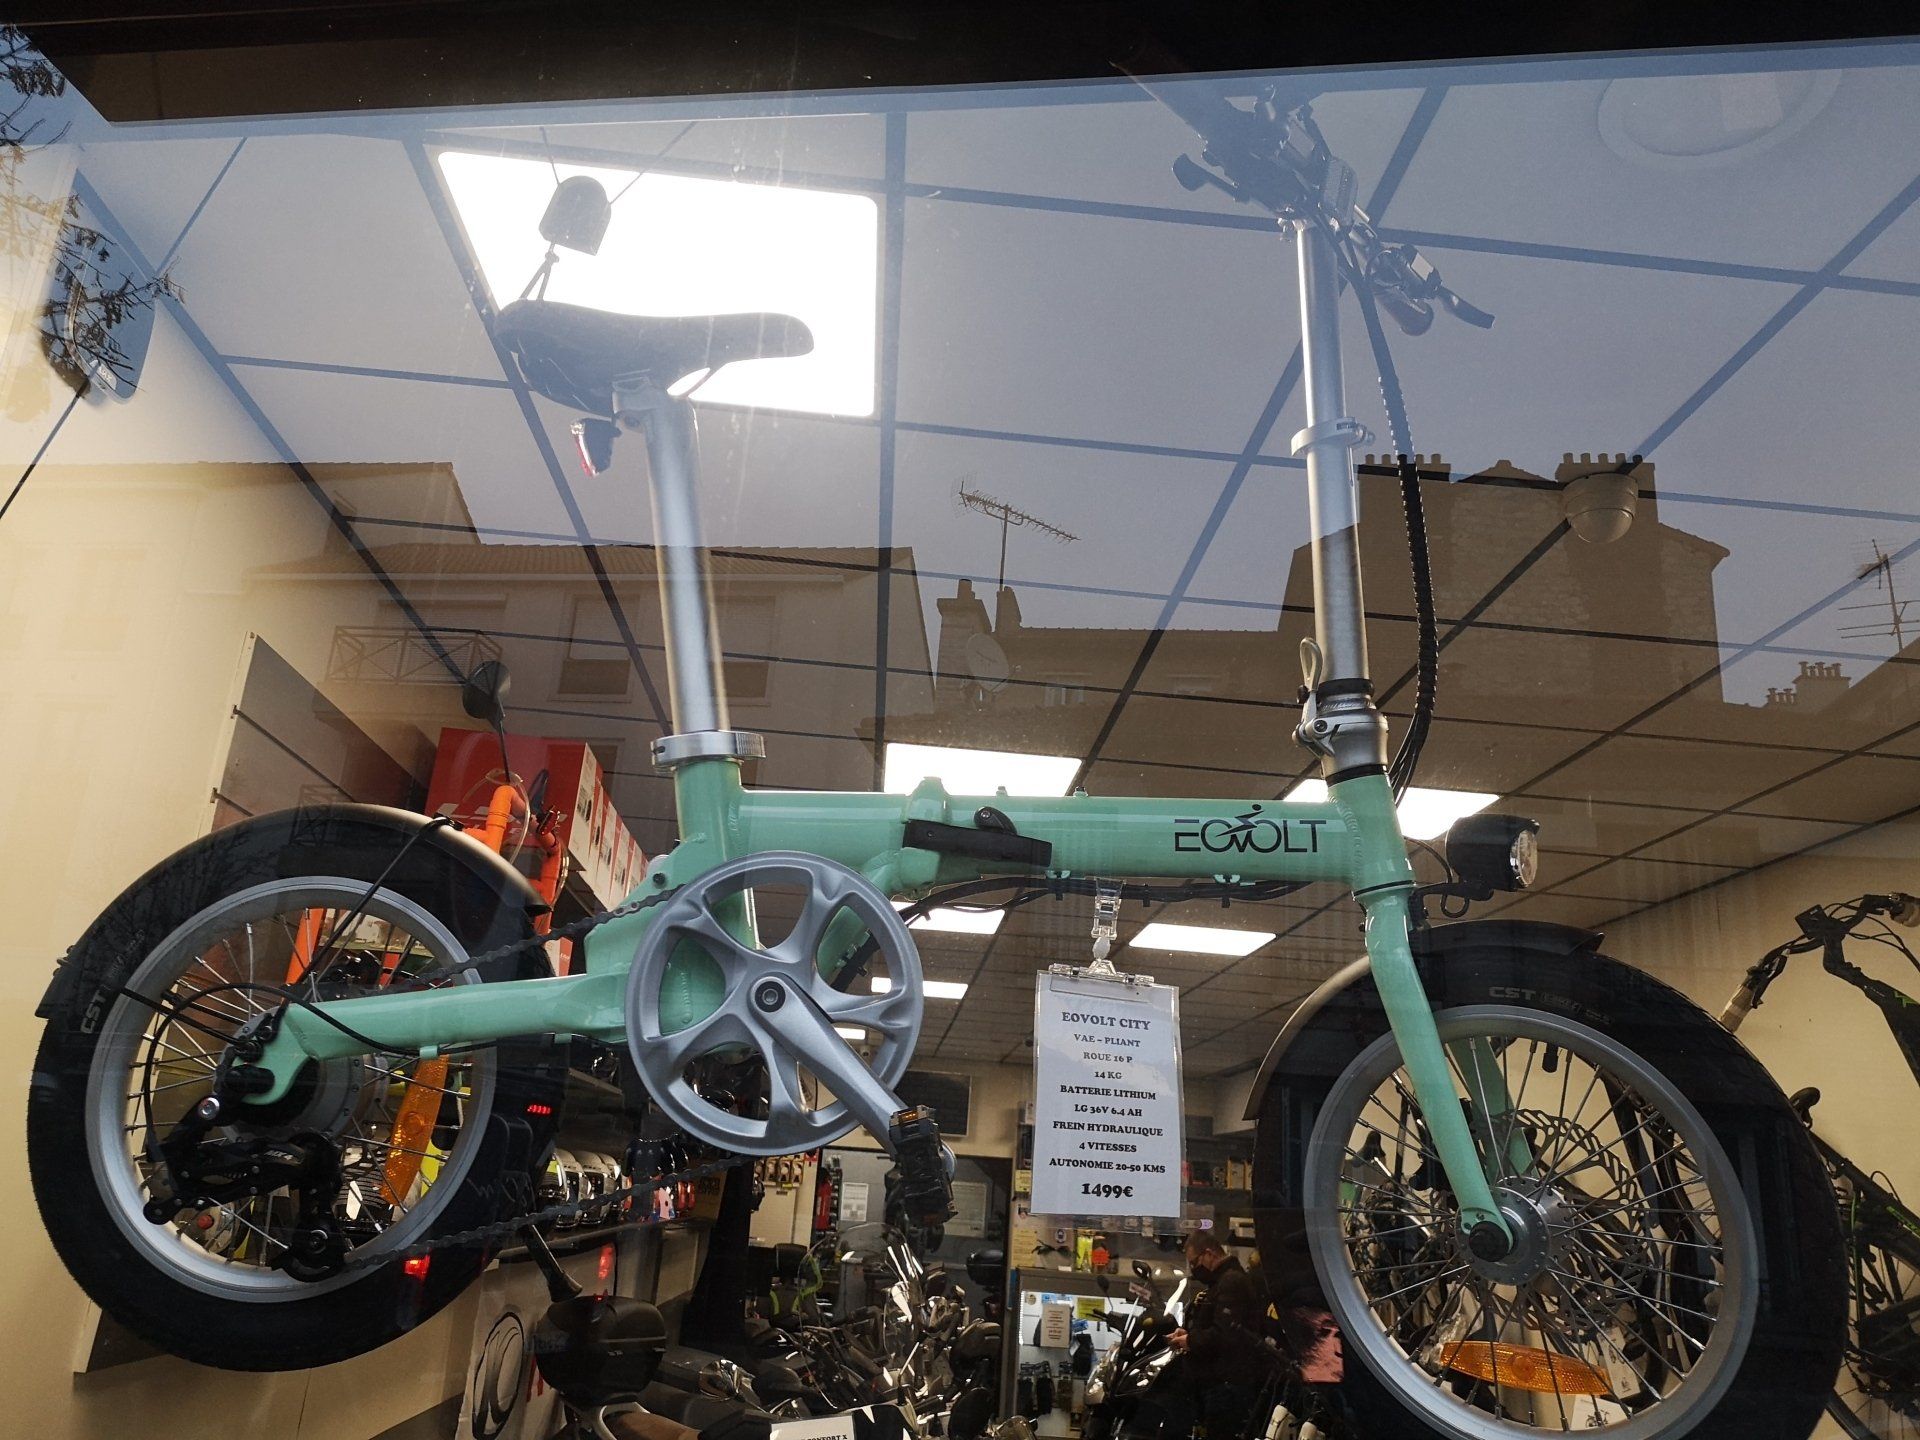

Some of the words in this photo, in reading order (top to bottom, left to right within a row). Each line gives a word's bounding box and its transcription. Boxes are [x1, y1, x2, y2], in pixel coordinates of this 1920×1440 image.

[1489, 986, 1536, 1000] CST
[79, 989, 107, 1034] CST
[1061, 1011, 1117, 1027] EOVOLT
[1118, 1018, 1151, 1031] CITY
[1073, 1033, 1096, 1043] VAE
[1104, 1036, 1141, 1048] PLIANT
[1083, 1051, 1112, 1062] ROUE
[1113, 1055, 1125, 1063] 16
[1126, 1055, 1133, 1064] P
[1094, 1071, 1106, 1079] 14
[1107, 1071, 1123, 1080] KG
[1059, 1084, 1113, 1097] BATTERIE
[1113, 1088, 1157, 1101] LITHIUM
[1074, 1103, 1089, 1113] LG
[1089, 1105, 1110, 1114] 36V
[1110, 1107, 1126, 1117] 6.4
[1126, 1108, 1143, 1117] AH
[1052, 1120, 1086, 1131] FREIN
[1086, 1122, 1164, 1137] HYDRAULIQUE
[1078, 1141, 1086, 1150] 4
[1087, 1141, 1137, 1153] VITESSES
[1048, 1157, 1115, 1170] AUTONOMIE
[1115, 1163, 1142, 1173] 20-50
[1143, 1163, 1166, 1174] KMS
[1080, 1182, 1134, 1199] 1499€
